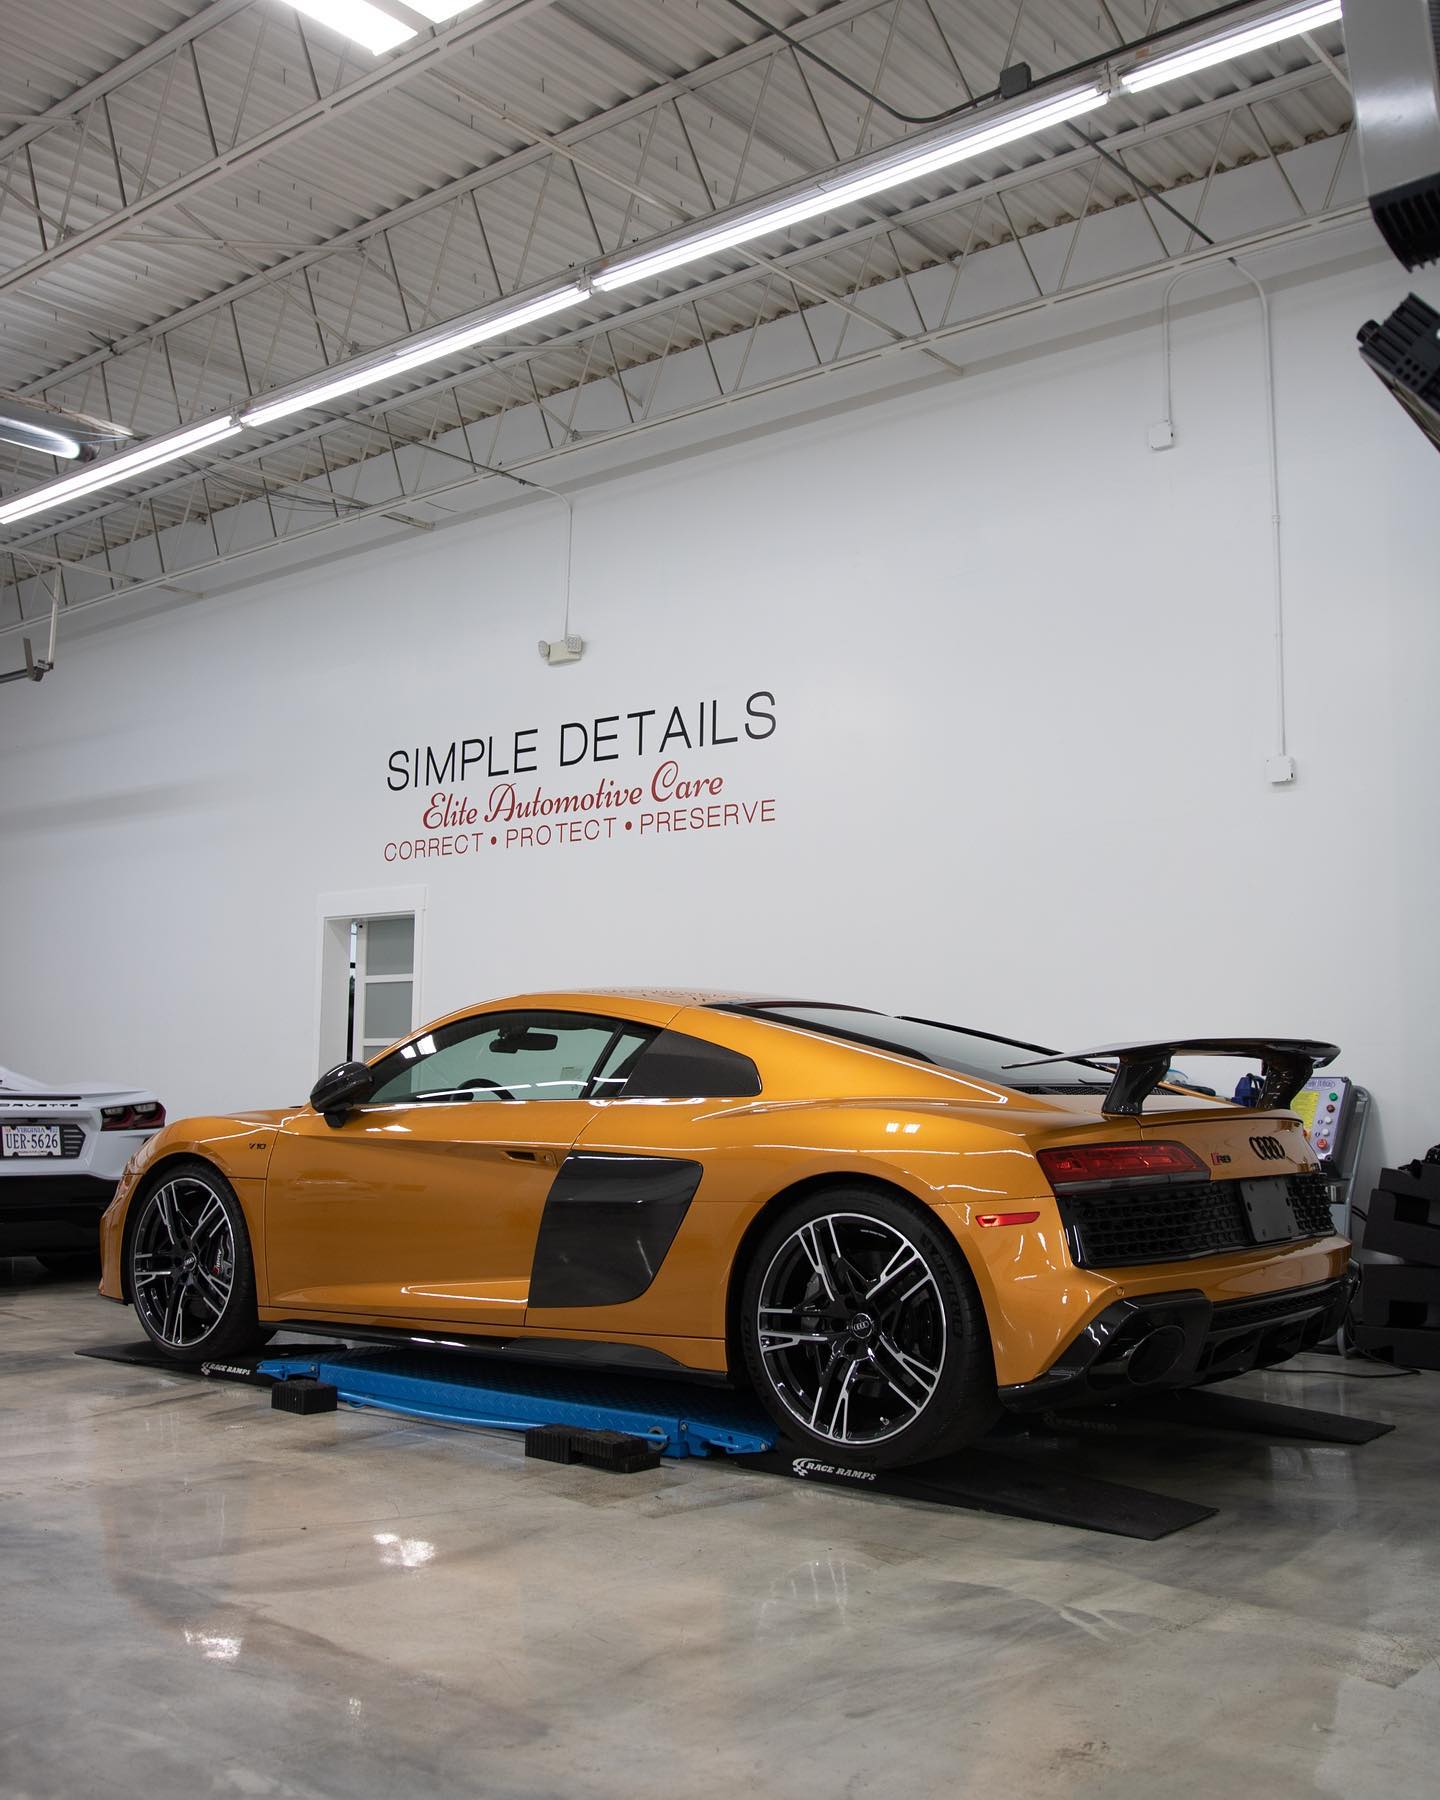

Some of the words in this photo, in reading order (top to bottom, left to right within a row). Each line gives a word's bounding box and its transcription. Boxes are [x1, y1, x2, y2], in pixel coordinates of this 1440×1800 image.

[386, 728, 539, 792] SIMPLE
[559, 690, 777, 768] DETAILS
[422, 791, 479, 830] Elite
[483, 778, 644, 823] Automotive
[650, 760, 724, 803] Care
[383, 831, 484, 862] CORRECT
[505, 816, 618, 849] PROTECT
[640, 798, 777, 836] PRESERVE
[6, 1133, 58, 1149] UER-5626
[208, 1363, 228, 1372] RACE
[226, 1366, 251, 1375] RAMPS
[805, 1462, 835, 1474] RACE
[835, 1467, 877, 1480] RAMPS
